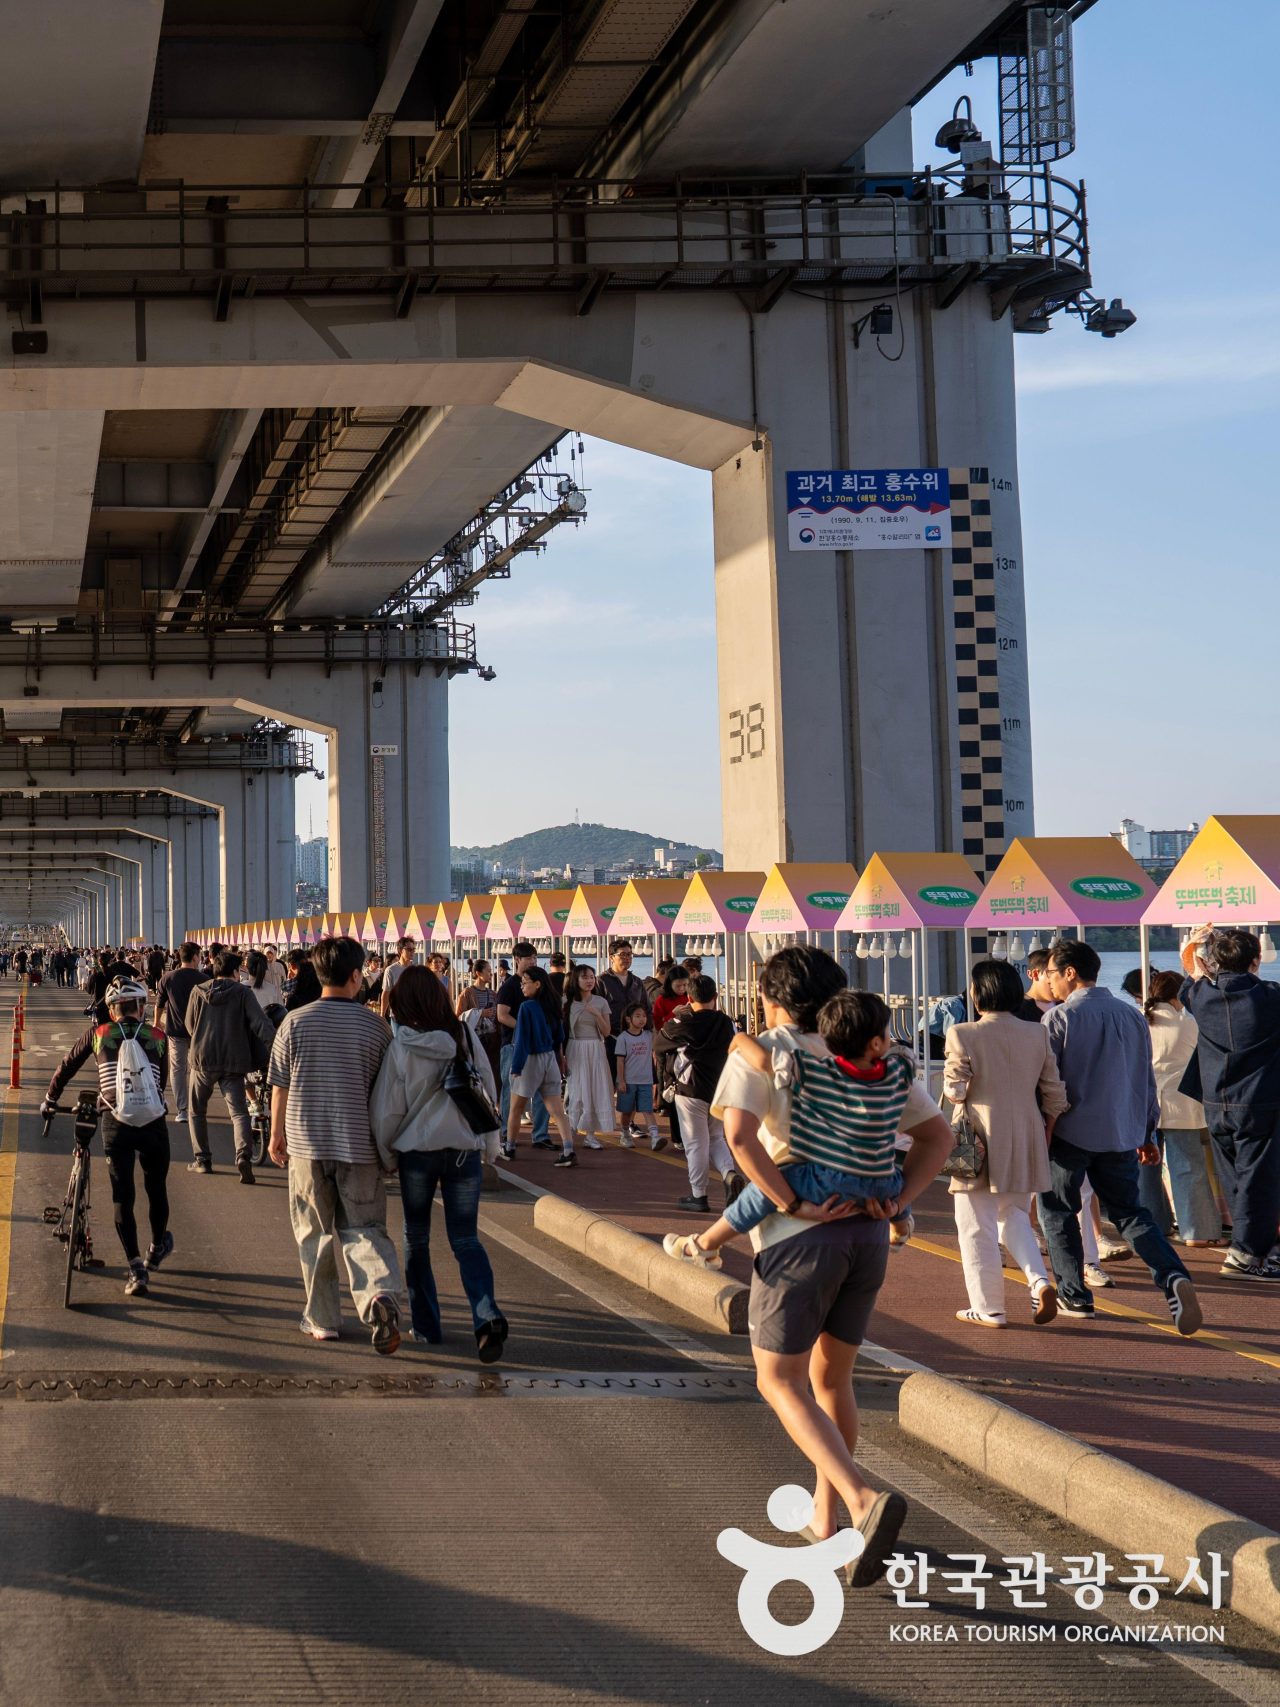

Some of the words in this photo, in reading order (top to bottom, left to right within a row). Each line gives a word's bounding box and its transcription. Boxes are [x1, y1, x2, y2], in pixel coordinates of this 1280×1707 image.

[797, 475, 833, 492] 과거
[841, 474, 877, 492] 최고
[885, 472, 940, 491] 홍수위
[991, 478, 1013, 491] 14m
[821, 494, 853, 503] 13.70m
[880, 493, 917, 503] 13.63m)
[995, 557, 1017, 570] 13m
[998, 637, 1018, 651] 12m
[1002, 717, 1021, 731] 11m
[729, 702, 765, 765] 38
[1005, 799, 1025, 812] 10m
[1175, 887, 1223, 909] 뚜벅뚜벅
[1225, 885, 1257, 907] 축제
[882, 902, 900, 918] 축제
[989, 897, 1025, 915] 뚜벅뚜벅
[1026, 896, 1049, 914] 축제
